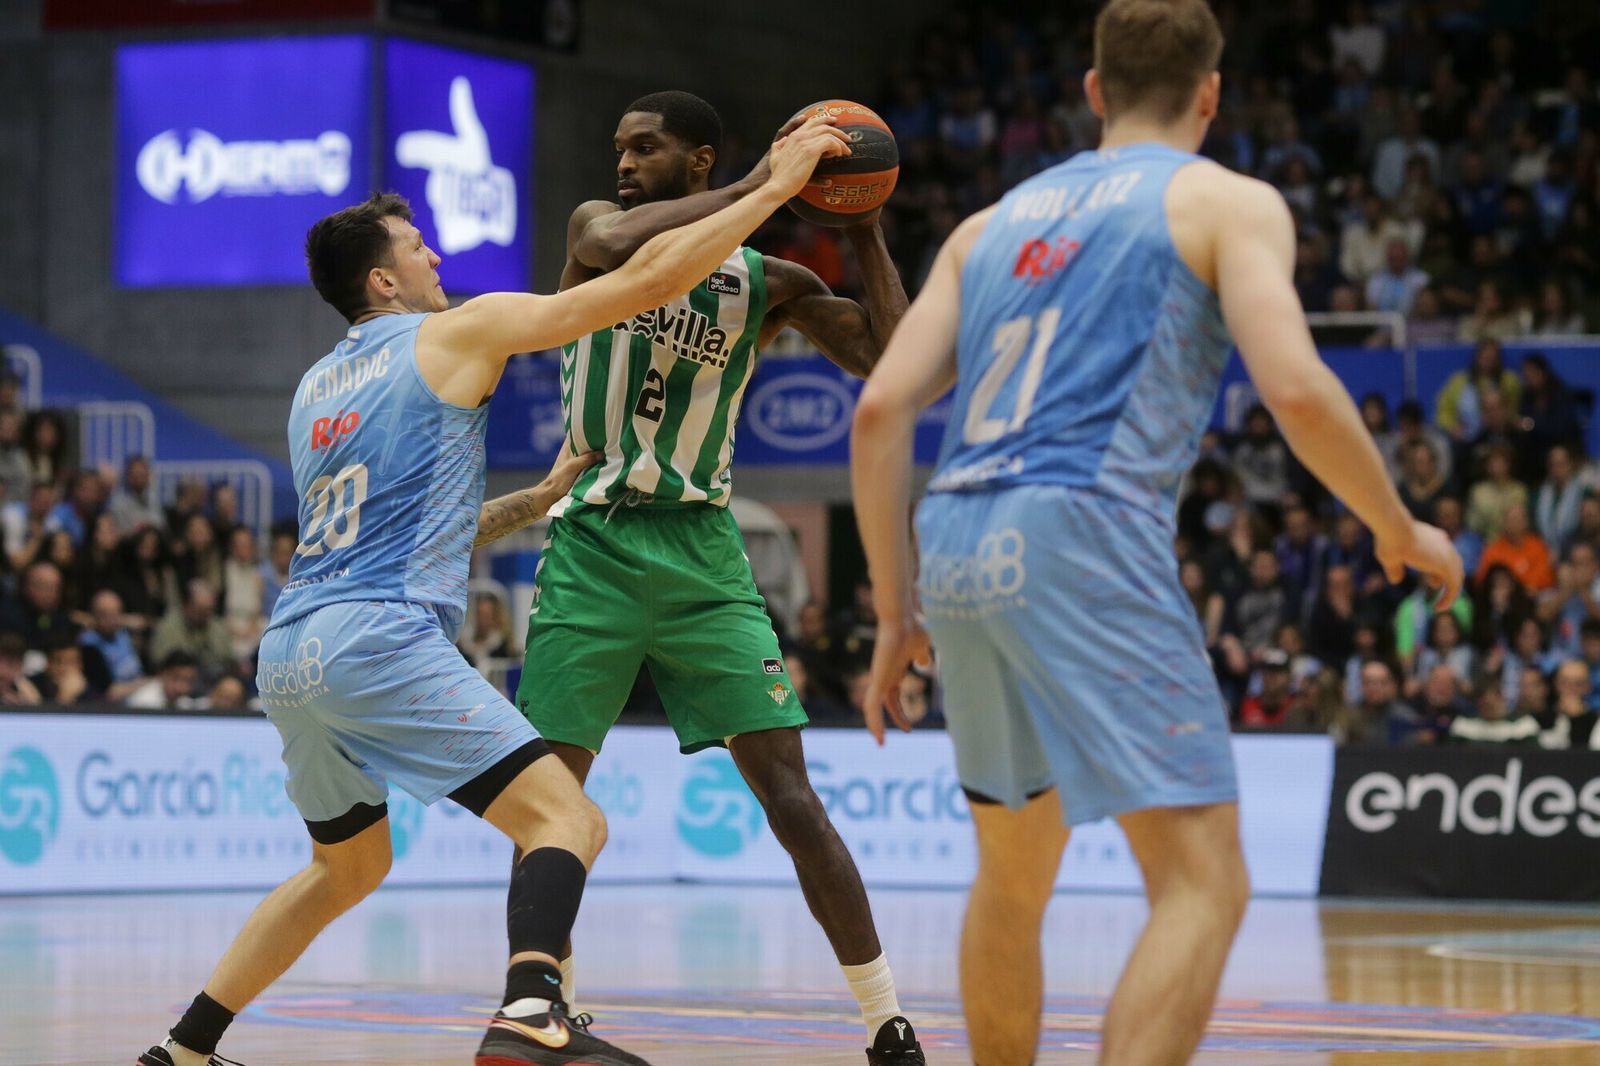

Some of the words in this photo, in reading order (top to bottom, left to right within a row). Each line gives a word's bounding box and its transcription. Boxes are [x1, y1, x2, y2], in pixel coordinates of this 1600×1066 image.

[710, 283, 739, 293] endesa
[711, 276, 725, 284] liga
[962, 307, 1063, 446] 21
[634, 368, 665, 423] 2
[296, 463, 369, 558] 20
[766, 663, 781, 672] acb
